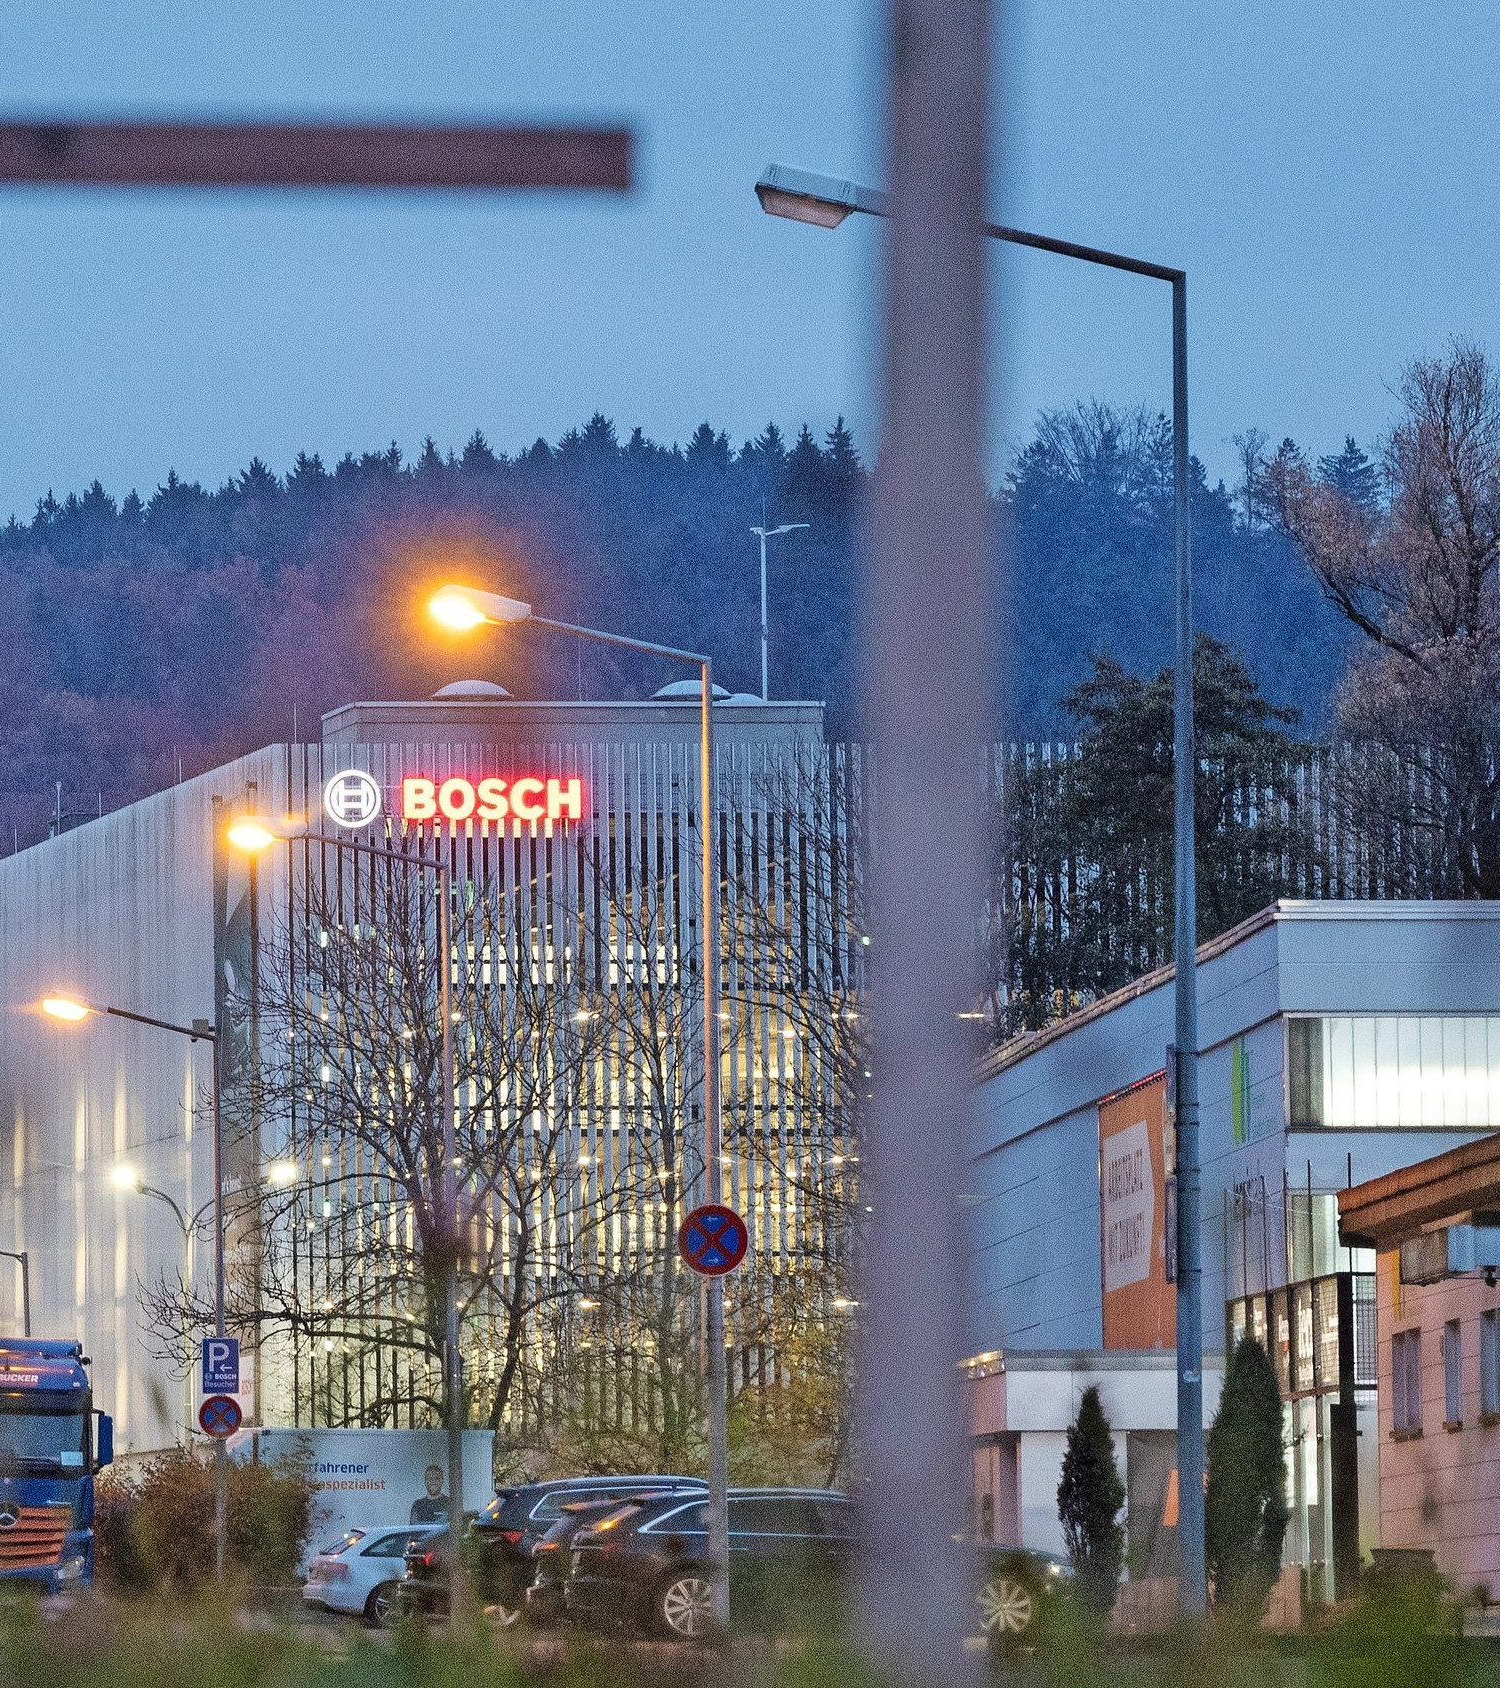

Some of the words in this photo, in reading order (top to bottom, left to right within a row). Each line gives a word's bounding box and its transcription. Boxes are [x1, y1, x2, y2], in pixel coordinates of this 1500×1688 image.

[403, 778, 582, 820] BOSCH
[209, 1343, 229, 1372] P
[204, 1380, 236, 1388] Besucher
